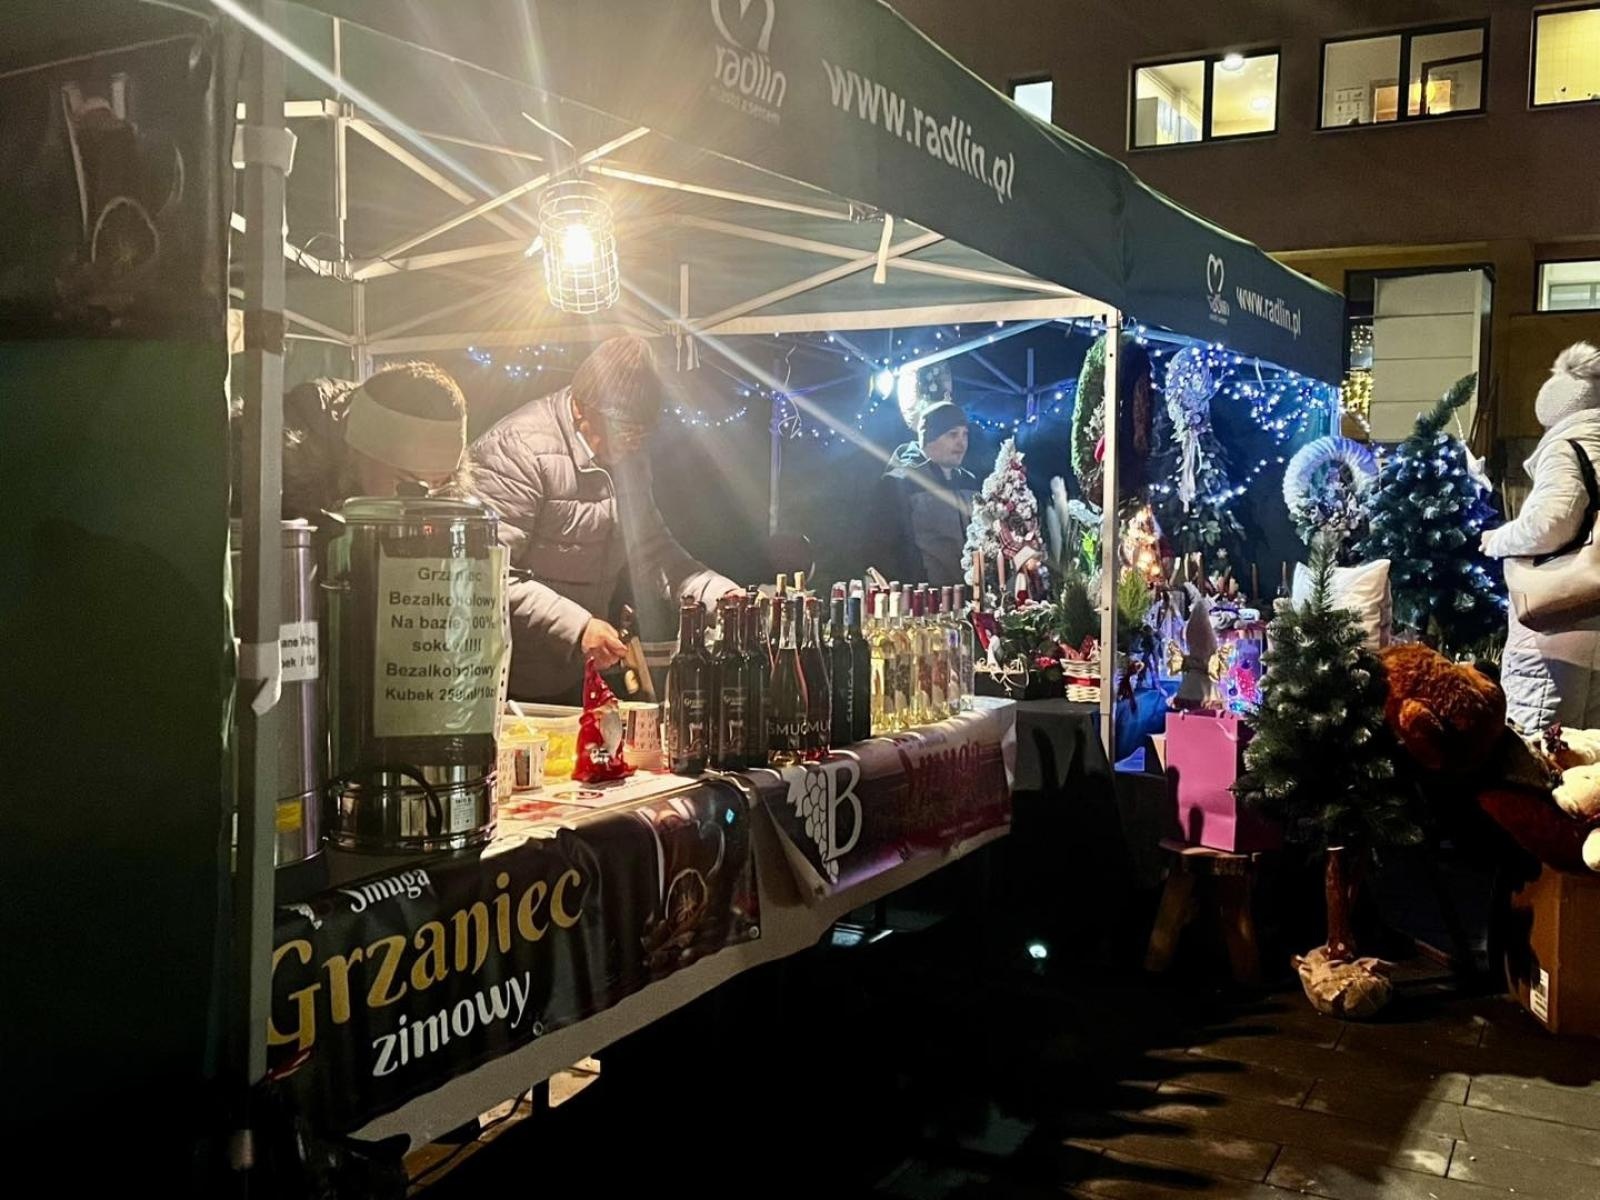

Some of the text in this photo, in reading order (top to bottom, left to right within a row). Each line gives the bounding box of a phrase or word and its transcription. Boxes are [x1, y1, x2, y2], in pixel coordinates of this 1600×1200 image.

[715, 45, 787, 107] radlin
[821, 58, 1016, 204] www.radlin.pl
[1235, 285, 1301, 340] www.radlin.pl
[390, 615, 496, 629] Na bazie 00%
[385, 686, 434, 701] Kubek
[266, 868, 583, 1050] Grzaniec
[372, 971, 531, 1077] zimowy
